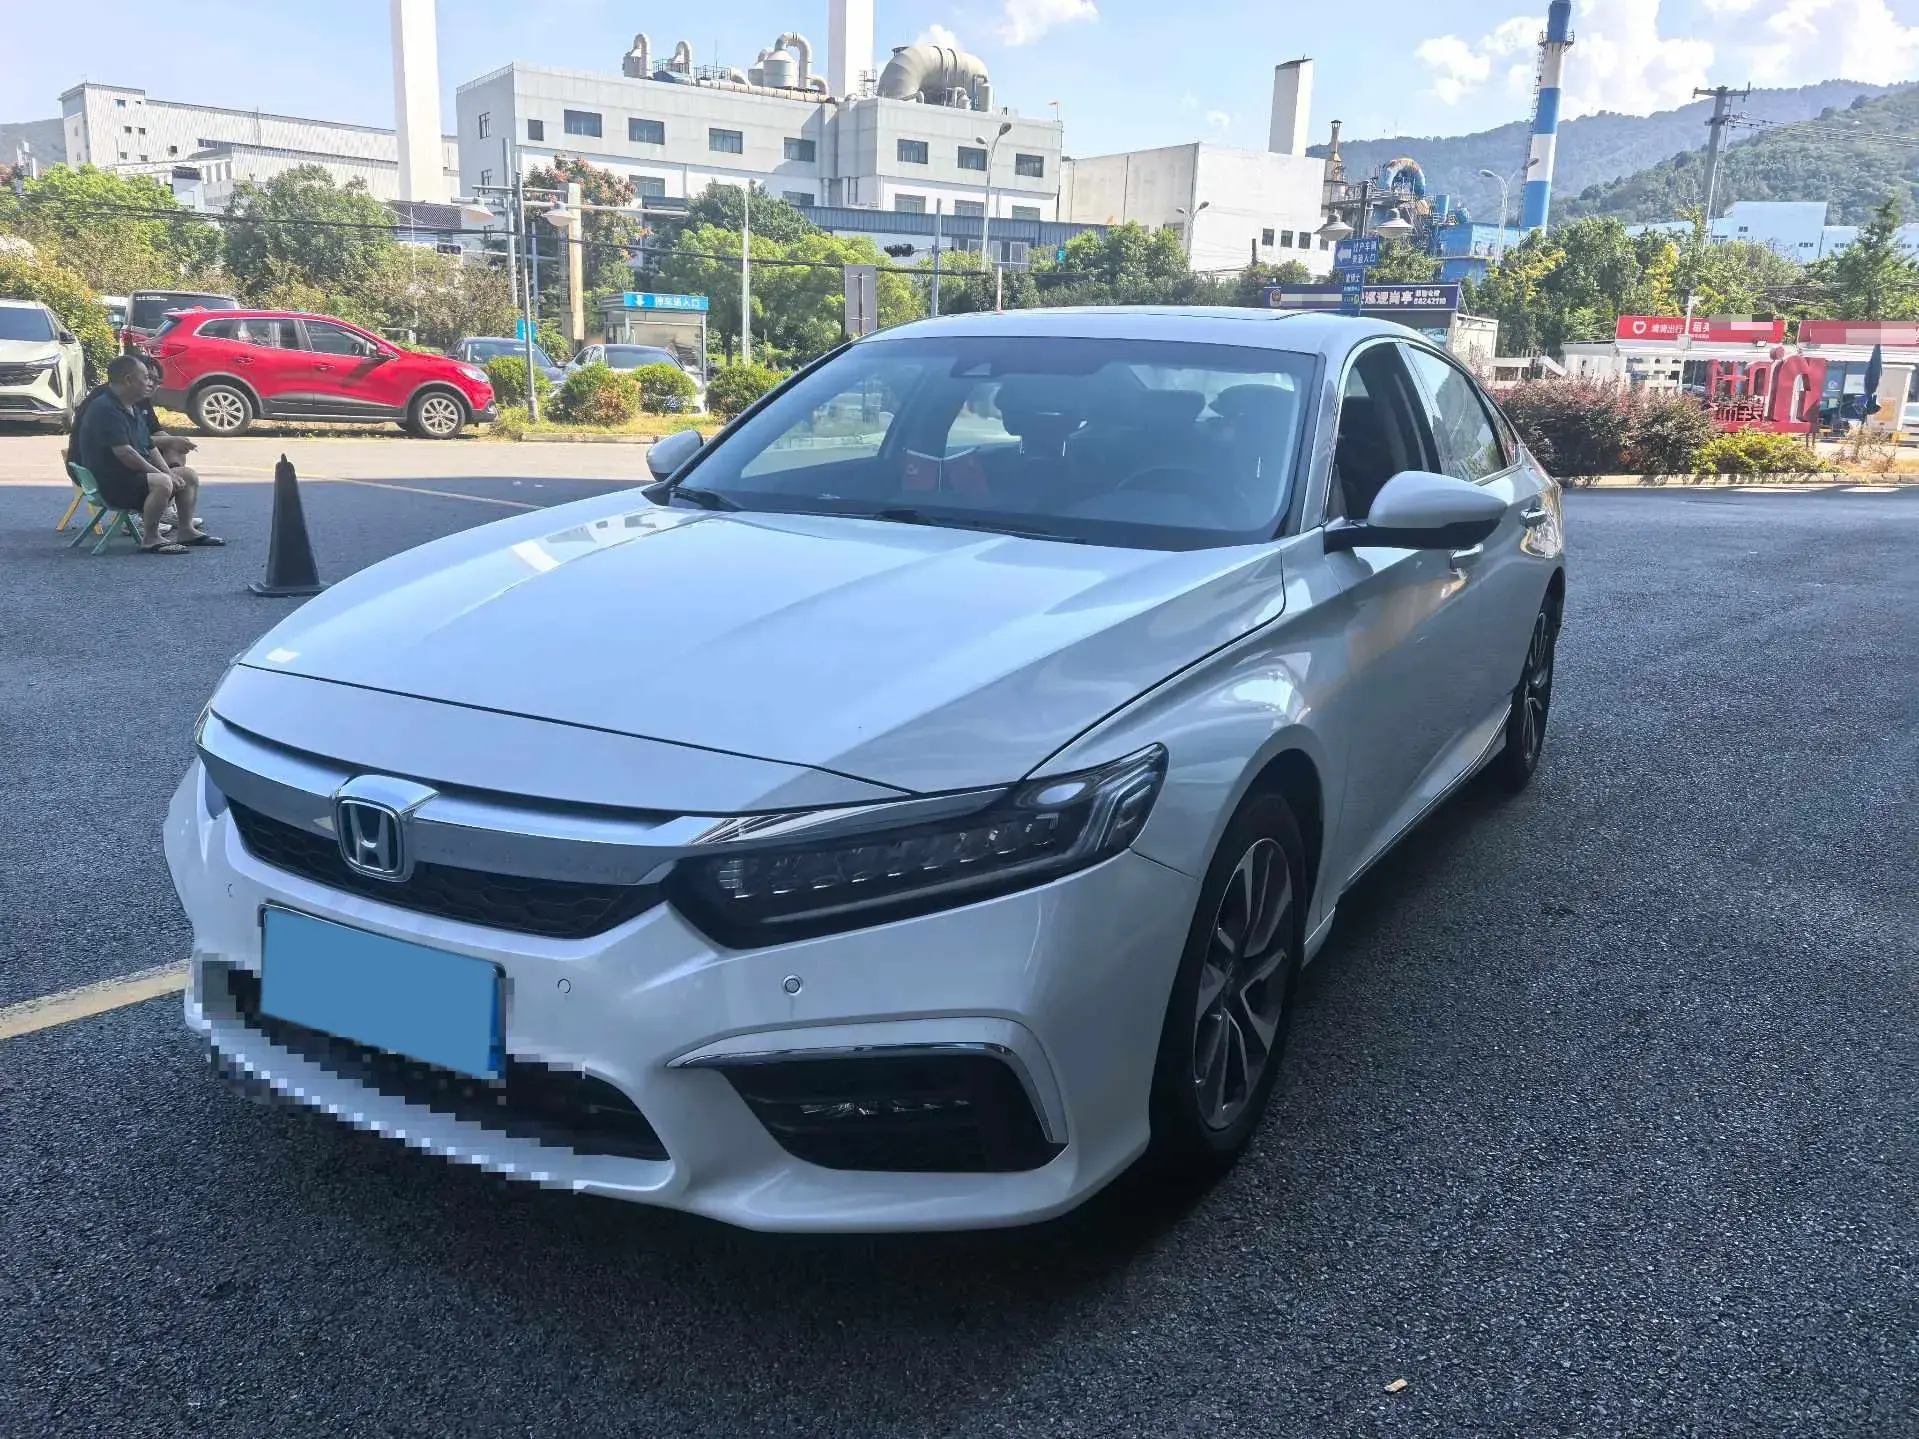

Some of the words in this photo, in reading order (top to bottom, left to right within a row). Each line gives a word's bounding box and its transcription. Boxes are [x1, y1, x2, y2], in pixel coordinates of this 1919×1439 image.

[655, 296, 700, 307] 停车场入口
[1361, 290, 1414, 305] 巡逻岗亭
[1651, 323, 1684, 334] 滴滴出行
